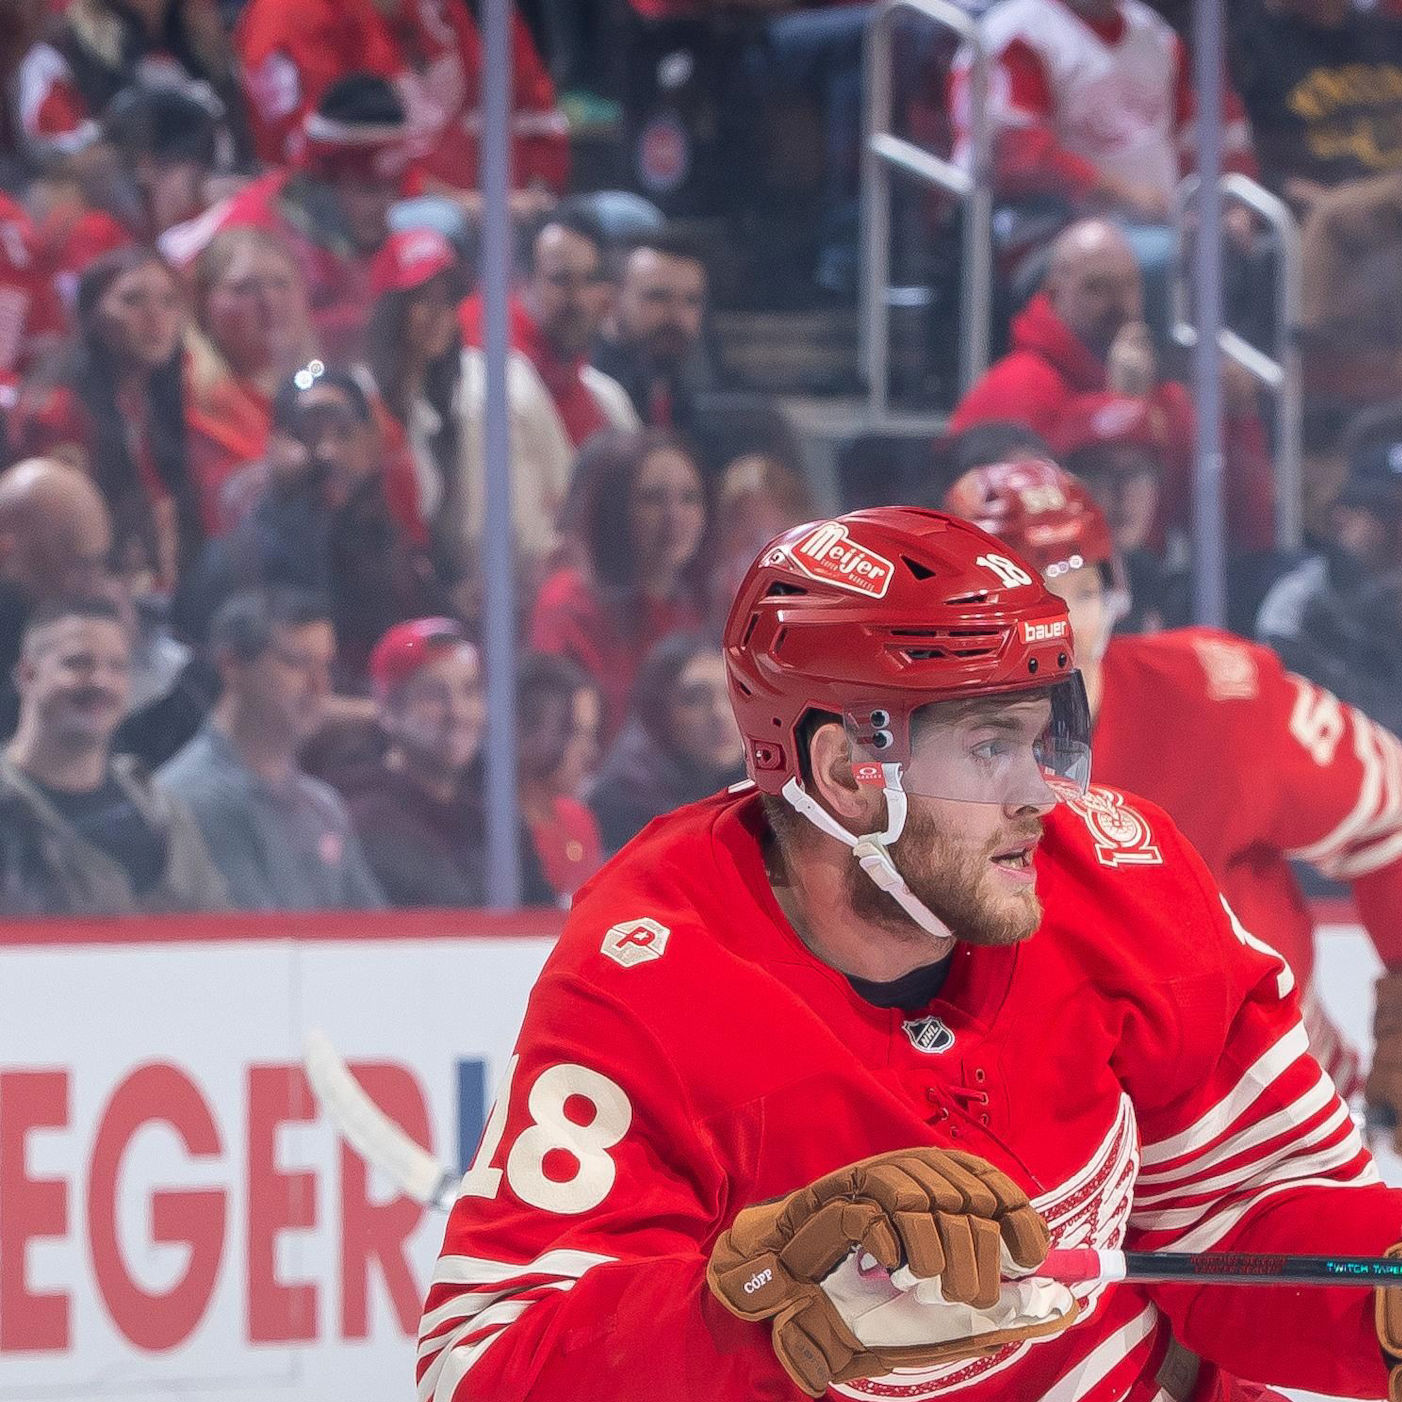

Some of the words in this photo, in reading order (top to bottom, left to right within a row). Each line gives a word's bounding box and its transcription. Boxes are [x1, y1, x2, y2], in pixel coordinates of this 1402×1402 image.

[800, 524, 886, 580] Meijer
[976, 553, 1033, 588] 18
[920, 1024, 939, 1048] NHL
[1326, 1261, 1369, 1273] TWITCH
[743, 1268, 773, 1294] COPP
